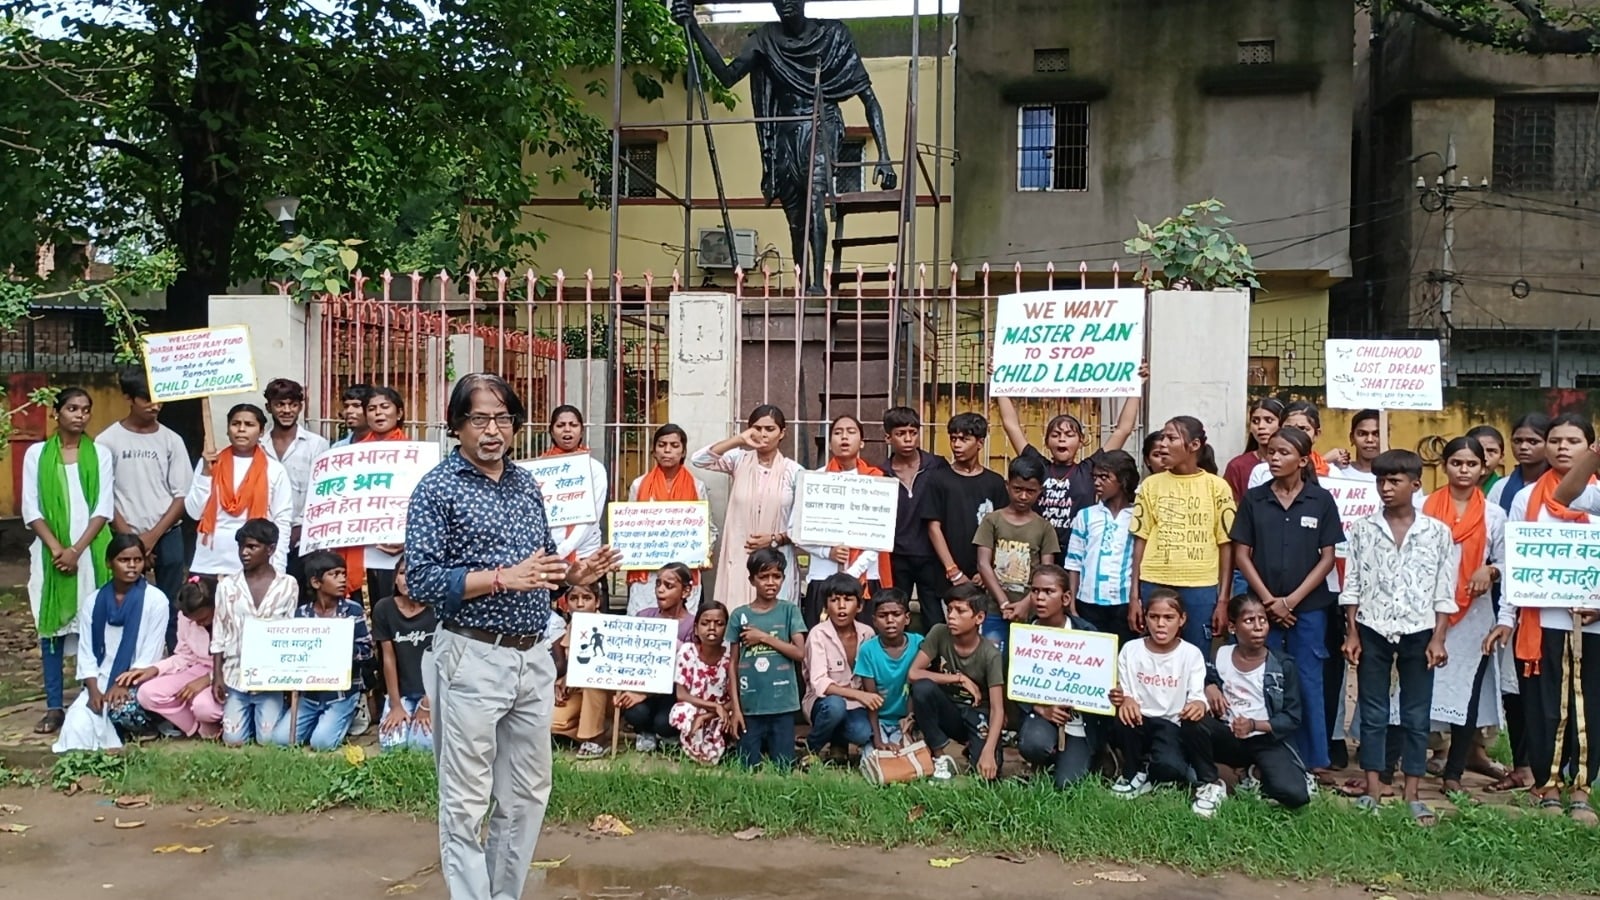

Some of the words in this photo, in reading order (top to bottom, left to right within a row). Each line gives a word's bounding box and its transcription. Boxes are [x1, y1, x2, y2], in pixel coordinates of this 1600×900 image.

[1023, 302, 1056, 319] WE
[1064, 300, 1118, 318] WANT
[168, 332, 211, 343] WELCOME
[1025, 347, 1041, 360] TO
[1049, 346, 1095, 359] STOP
[1356, 346, 1422, 359] CHILDHOOD
[993, 363, 1048, 383] CHILD
[1053, 361, 1135, 382] LABOUR
[1387, 363, 1436, 375] DREAMS
[154, 380, 190, 393] CHILD
[194, 373, 244, 388] LABOUR
[1360, 377, 1425, 390] SHATTERED
[312, 456, 330, 481] हम
[534, 465, 561, 477] भारत
[315, 476, 348, 497] बाल
[353, 472, 395, 492] श्रम
[555, 475, 586, 490] रोकने
[806, 483, 821, 495] हर
[556, 490, 587, 503] प्लान
[1346, 487, 1367, 499] ARE
[1188, 495, 1200, 510] GO
[1343, 505, 1375, 516] LEARN
[307, 521, 343, 540] प्लान
[347, 512, 395, 534] चाहते
[1187, 530, 1208, 543] OWN
[1559, 529, 1587, 539] प्लान
[1187, 547, 1205, 560] WAY
[1516, 542, 1573, 558] बचपन
[1512, 566, 1544, 588] बाल
[1547, 565, 1600, 592] मजदूरी
[1031, 634, 1048, 647] We
[1053, 640, 1086, 650] want
[1015, 646, 1063, 662] MASTER
[1067, 654, 1104, 668] PLAN
[268, 675, 303, 685] Children
[1031, 663, 1044, 675] to
[1049, 667, 1081, 682] stop
[1136, 671, 1178, 688] Forever
[1012, 675, 1052, 690] CHILD
[1055, 681, 1106, 699] LABOUR
